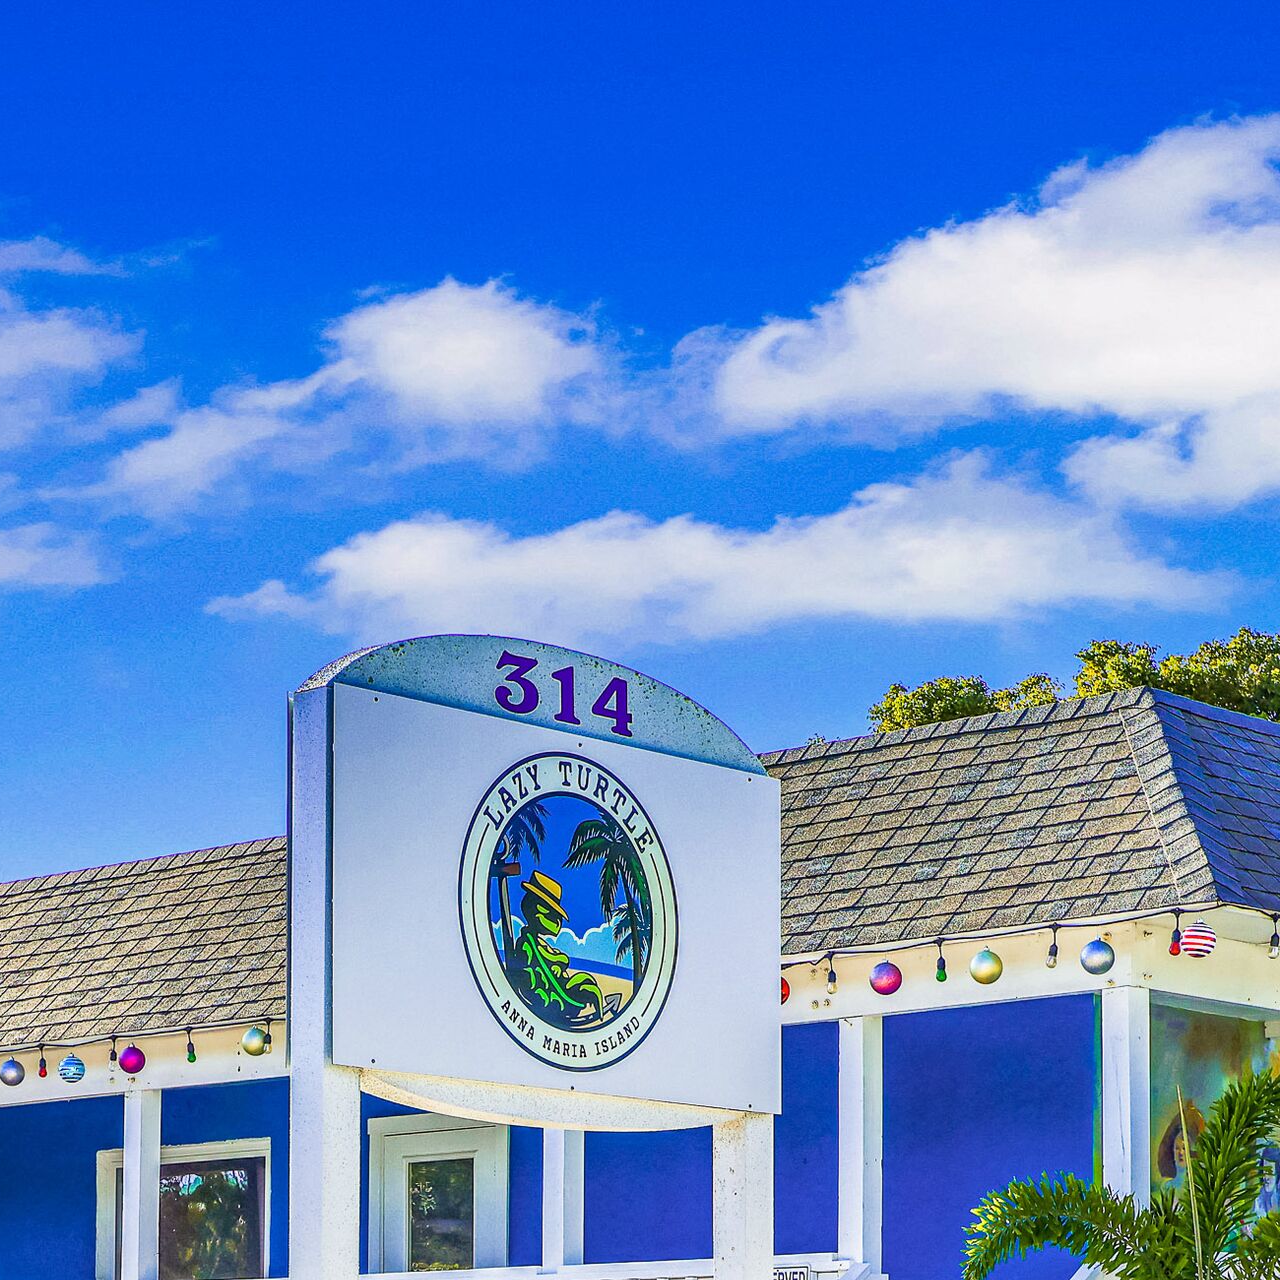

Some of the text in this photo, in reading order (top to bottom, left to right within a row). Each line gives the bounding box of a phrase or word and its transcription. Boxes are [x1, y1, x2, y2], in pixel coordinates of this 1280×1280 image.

[495, 650, 633, 737] 314
[482, 760, 655, 854] LAZY TURTLE
[501, 999, 641, 1059] ANNA MARIA ISLAND
